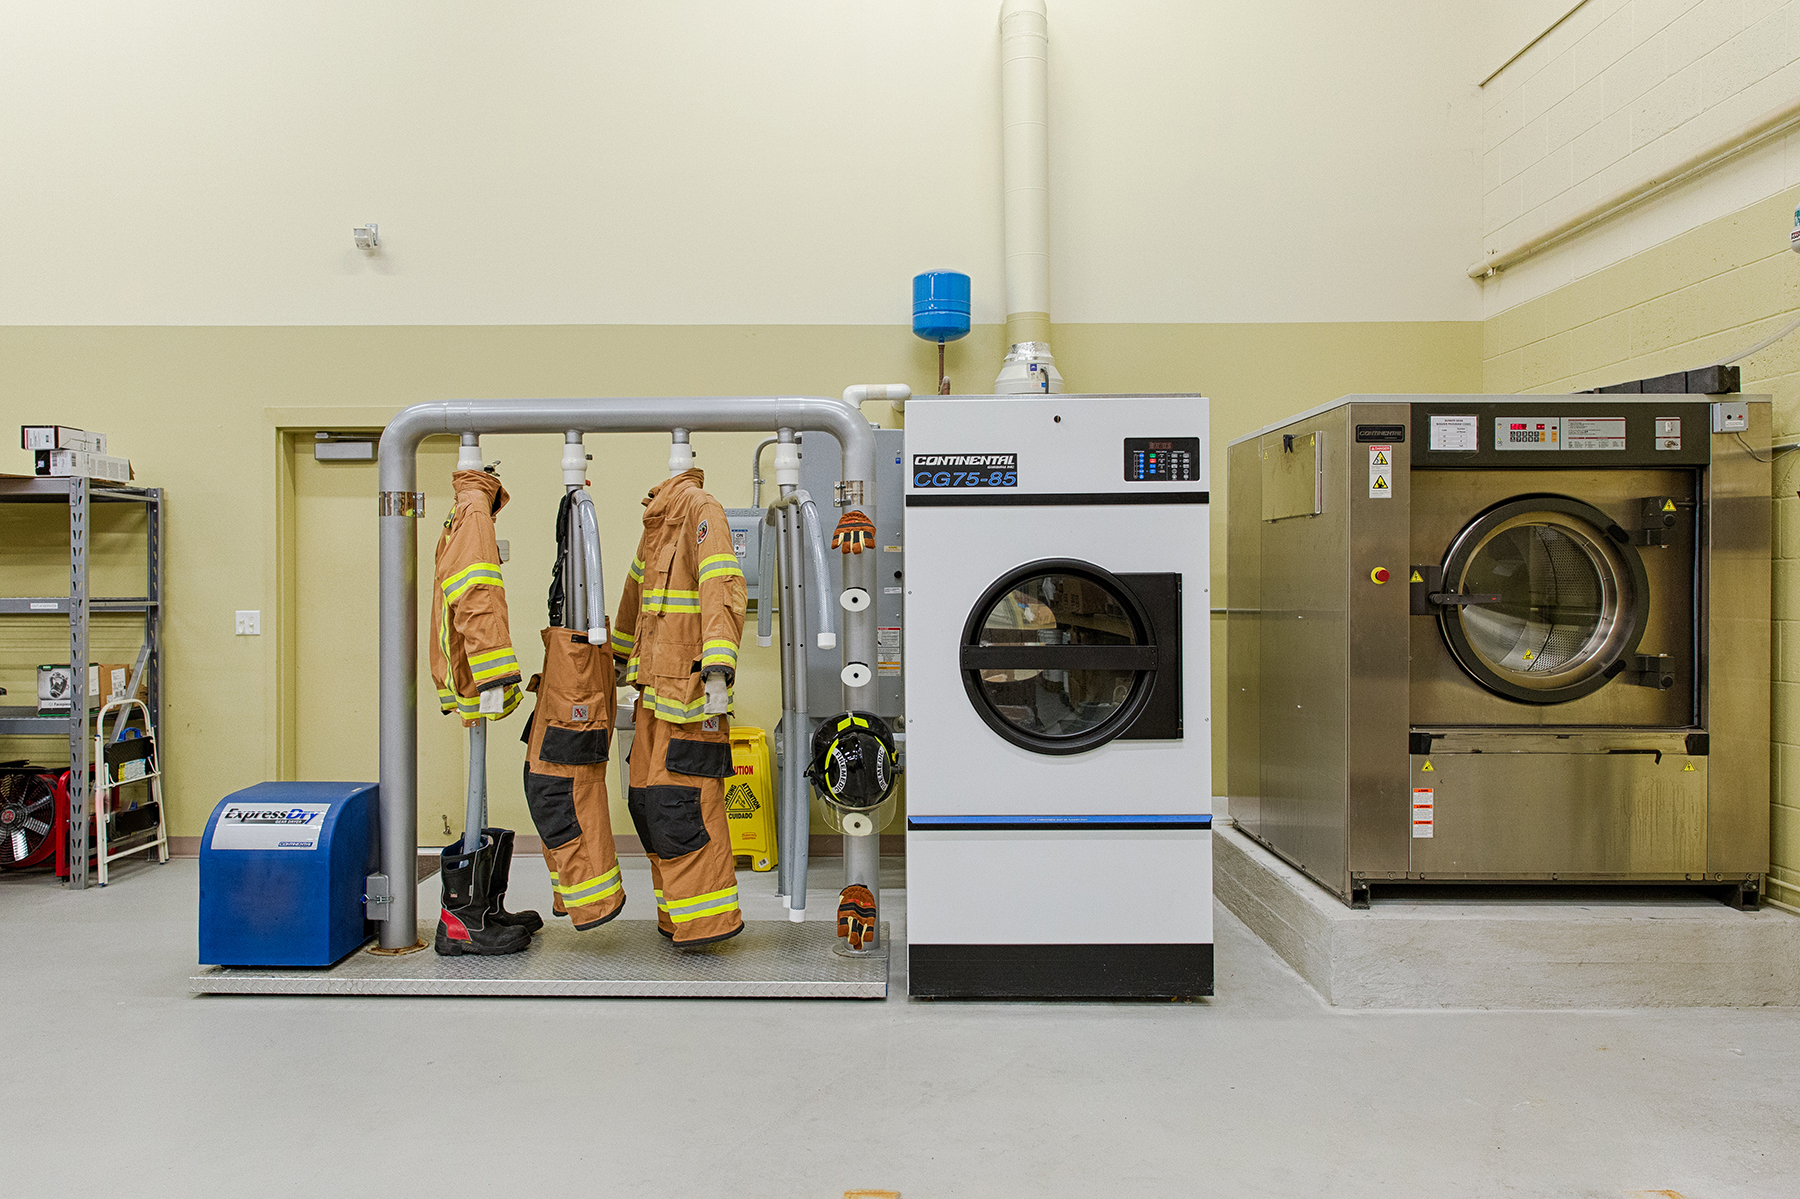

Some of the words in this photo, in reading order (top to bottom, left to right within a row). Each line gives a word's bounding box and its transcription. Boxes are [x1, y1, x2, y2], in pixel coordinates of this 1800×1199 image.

[915, 455, 1015, 466] CONTINENTAL
[914, 472, 1016, 486] CG75-85
[734, 766, 754, 775] UTION
[742, 782, 761, 810] ATTENTION
[224, 808, 320, 824] ExpressDry
